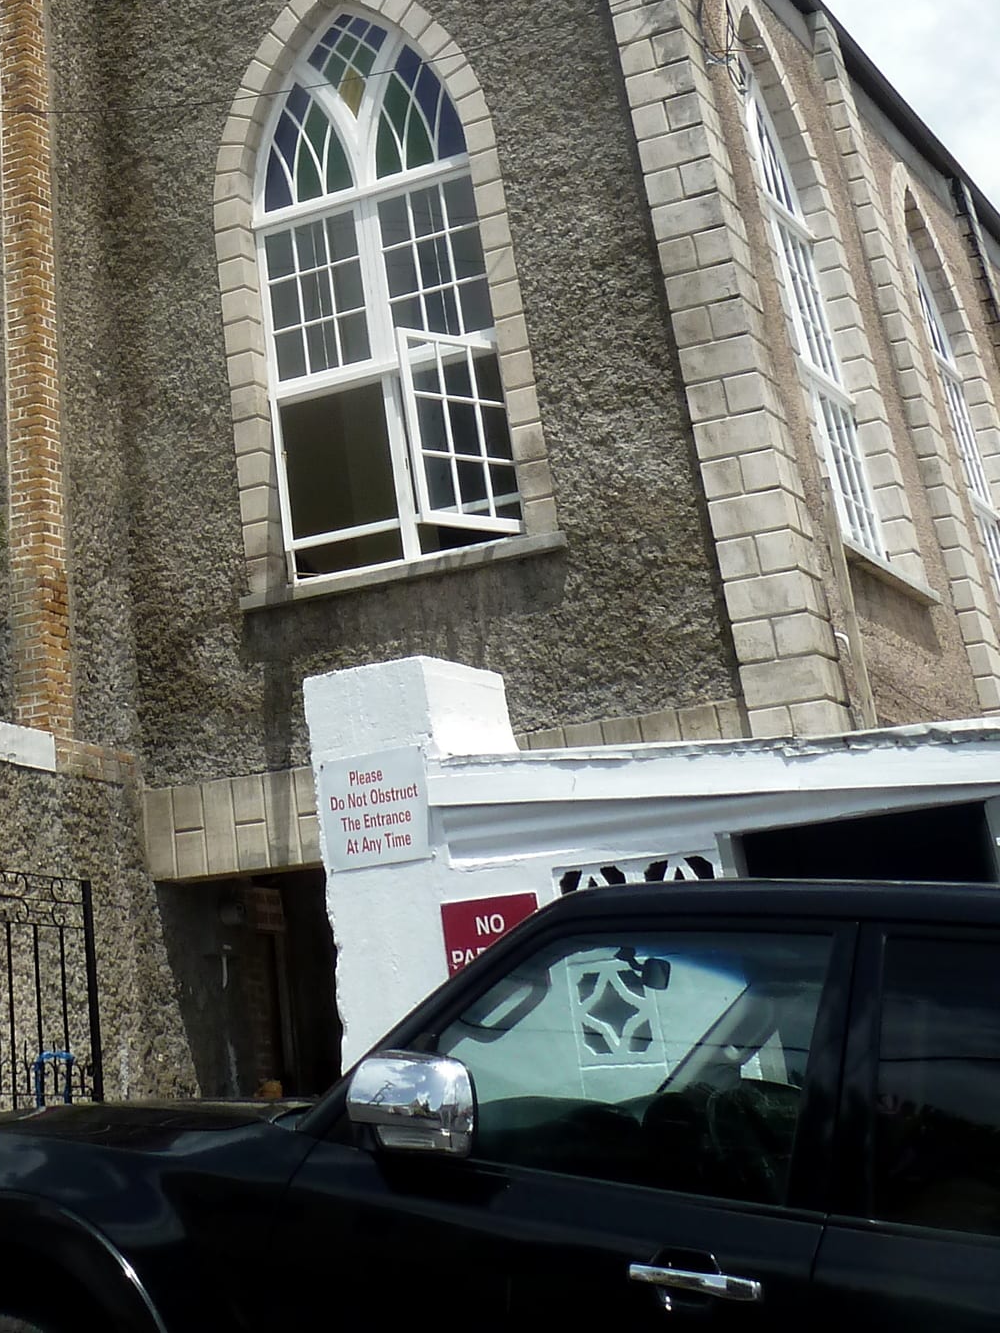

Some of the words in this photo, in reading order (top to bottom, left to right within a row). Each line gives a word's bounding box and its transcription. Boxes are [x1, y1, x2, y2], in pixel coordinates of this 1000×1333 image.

[349, 769, 383, 786] Please
[330, 796, 345, 811] Do
[347, 792, 368, 809] Not
[370, 783, 418, 805] Obstruct
[340, 817, 361, 832] The
[363, 810, 411, 829] Entrance
[346, 838, 359, 855] At
[362, 837, 382, 854] Any
[384, 832, 412, 849] Time
[475, 913, 505, 936] NO
